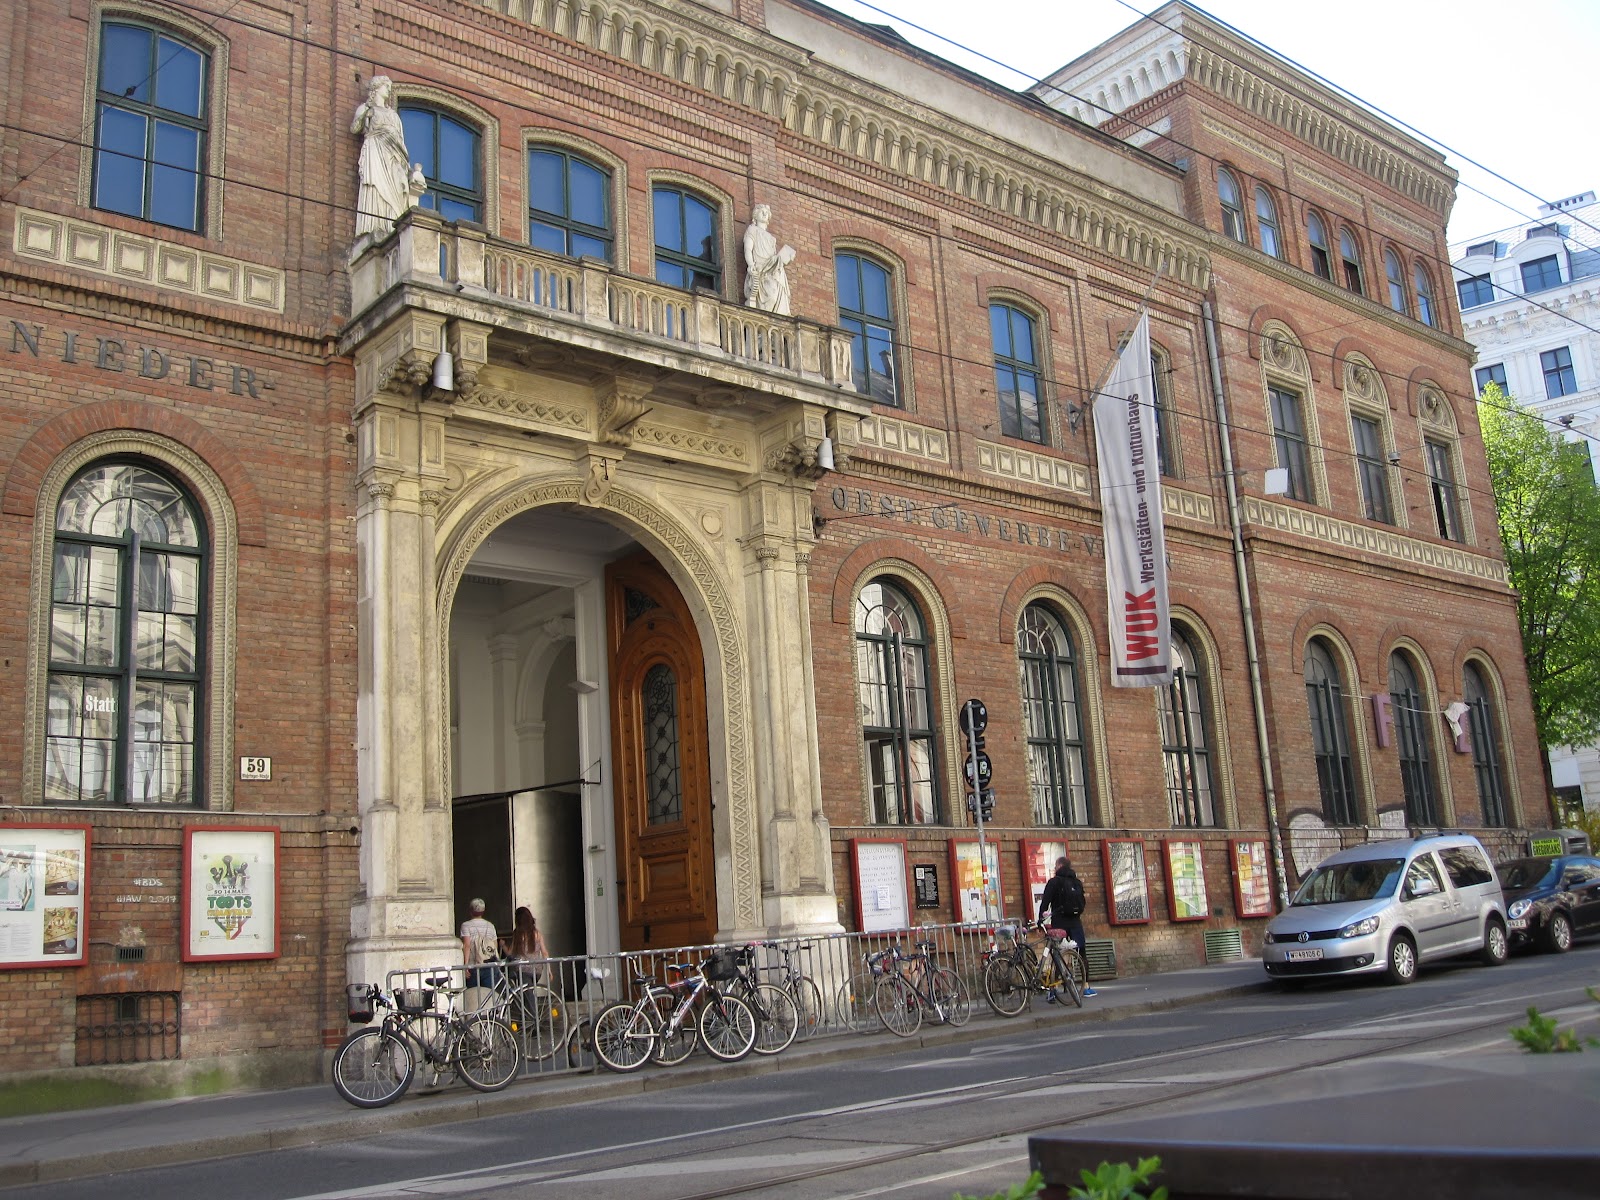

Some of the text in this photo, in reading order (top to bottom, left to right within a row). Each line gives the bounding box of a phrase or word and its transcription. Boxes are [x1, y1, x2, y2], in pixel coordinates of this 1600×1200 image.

[1125, 393, 1159, 661] WUK Werkstätten- und Kulturhaus
[85, 694, 116, 713] Statt
[247, 758, 266, 773] 59
[148, 895, 177, 903] 2017
[207, 896, 252, 909] TOOTS
